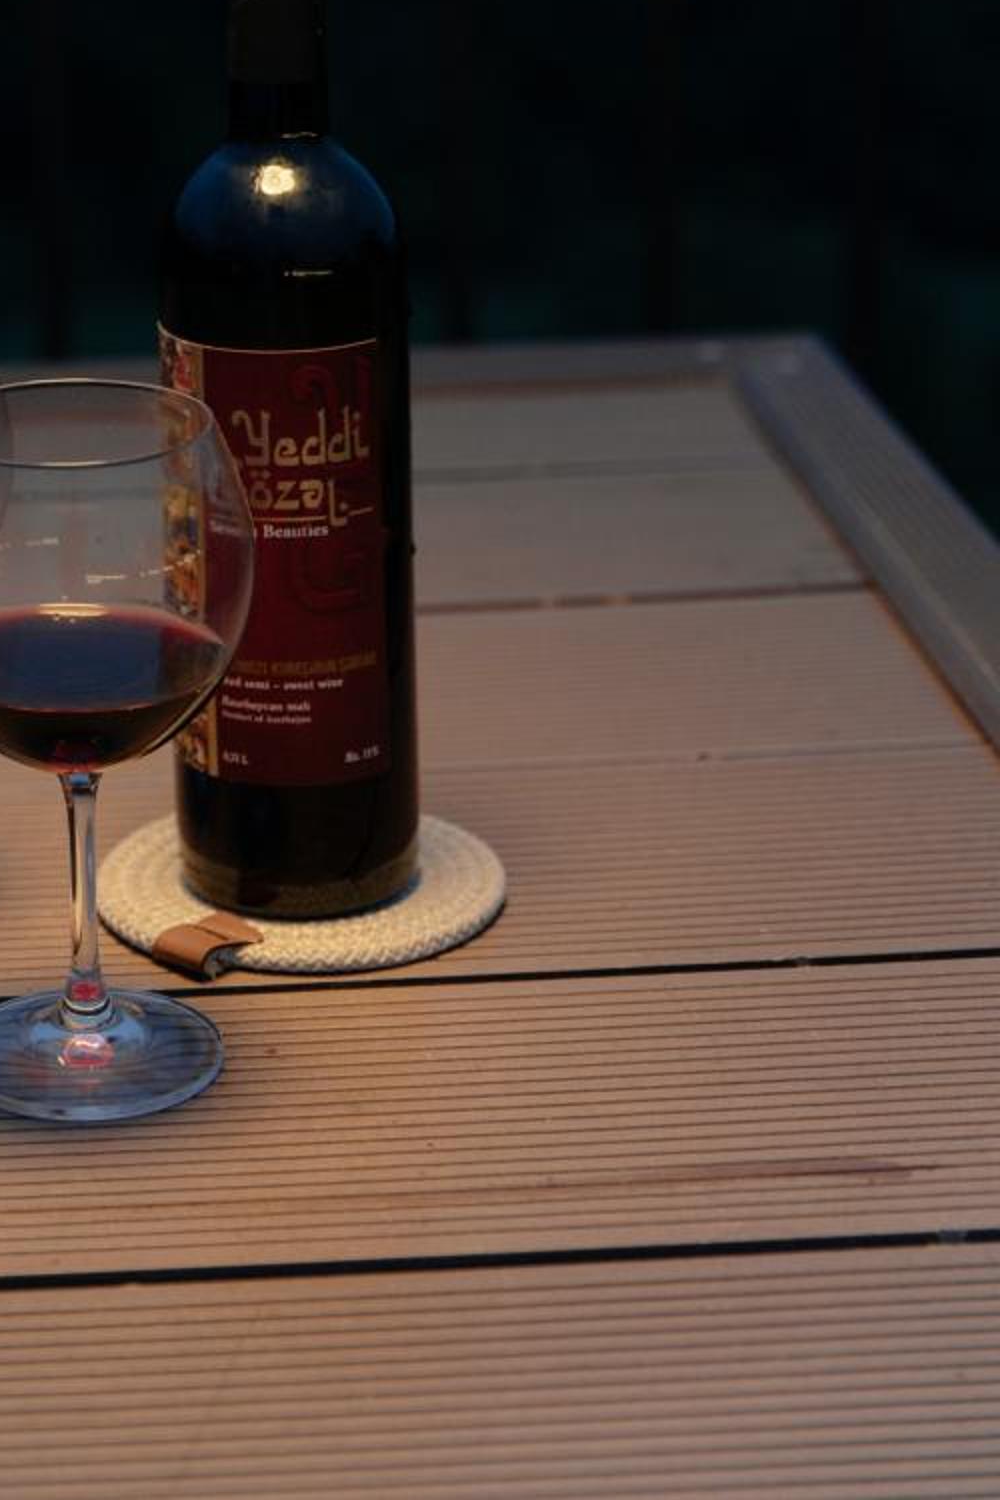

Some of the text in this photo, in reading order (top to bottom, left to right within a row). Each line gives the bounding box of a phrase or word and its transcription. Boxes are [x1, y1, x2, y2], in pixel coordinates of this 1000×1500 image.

[231, 404, 370, 467] Yeddi
[210, 470, 352, 527] özəl
[263, 524, 328, 539] Beauties
